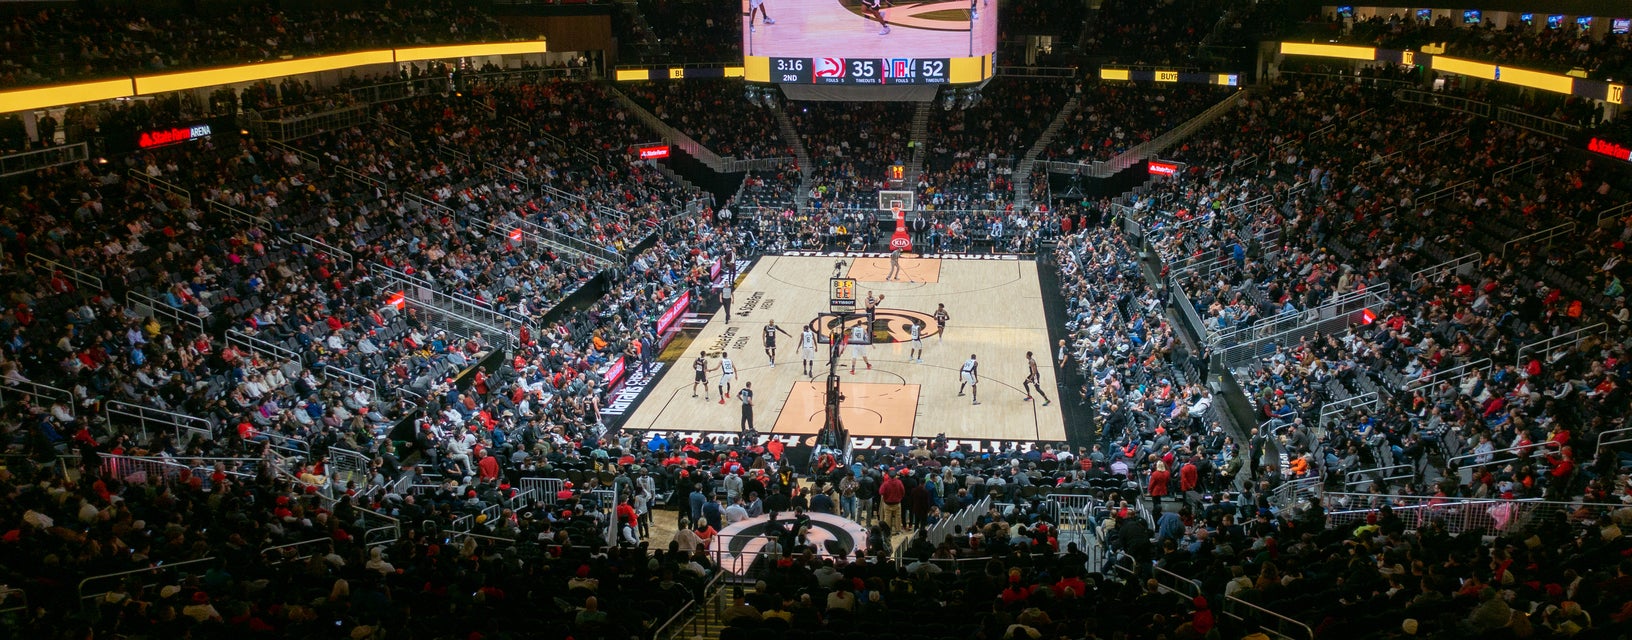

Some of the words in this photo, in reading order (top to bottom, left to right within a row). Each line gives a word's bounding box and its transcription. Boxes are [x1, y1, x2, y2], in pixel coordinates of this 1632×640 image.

[777, 59, 803, 71] 3:16
[852, 61, 874, 77] 35
[922, 61, 944, 77] 52
[783, 74, 797, 82] 2ND
[190, 125, 211, 138] ARENA
[600, 385, 645, 415] Harrah's
